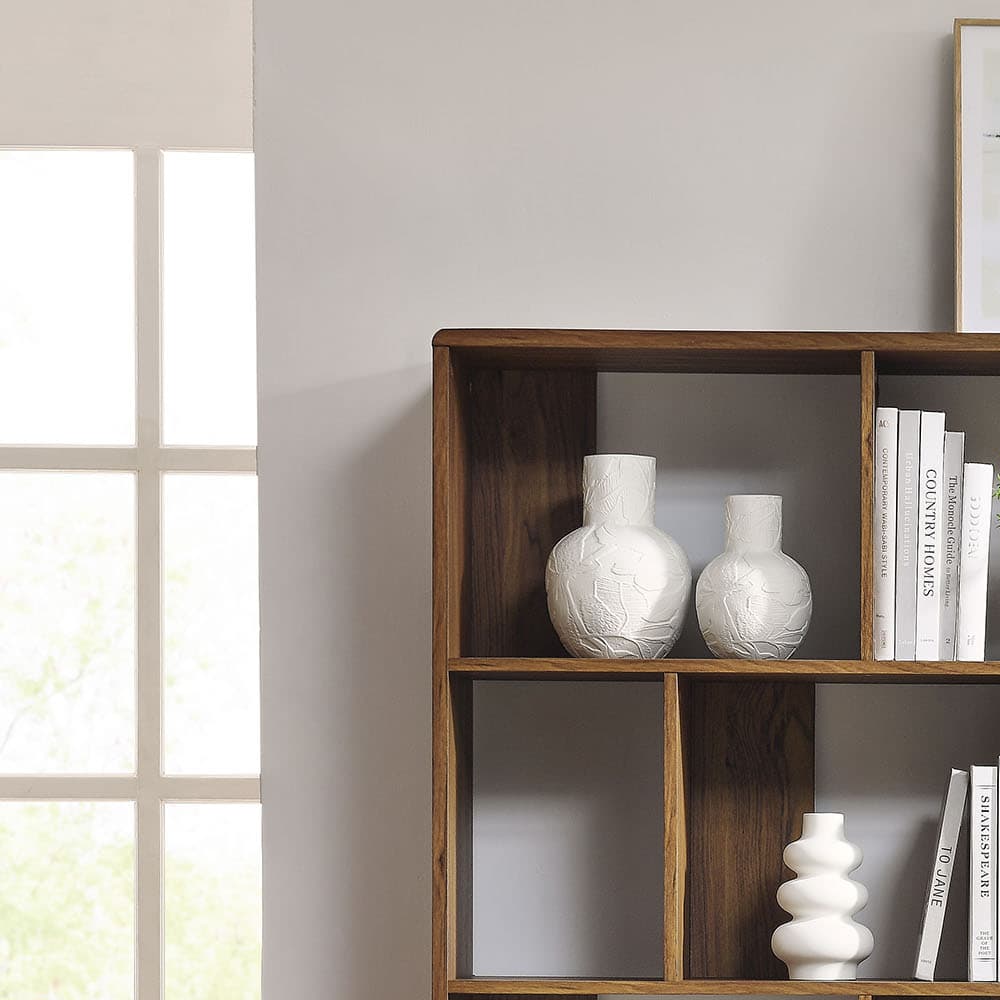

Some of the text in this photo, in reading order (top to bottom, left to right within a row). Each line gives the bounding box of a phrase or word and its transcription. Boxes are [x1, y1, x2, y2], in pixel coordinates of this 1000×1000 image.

[880, 447, 889, 579] CONTEMPORARY WABI-SABI STYLE
[902, 452, 914, 567] Urban Hallucinations
[946, 495, 957, 535] Monocle
[948, 475, 959, 494] The
[923, 469, 938, 597] COUNTRY HOMES
[945, 536, 956, 565] Guide
[930, 846, 953, 908] TO JANE
[980, 795, 990, 898] SHAKESPEARE
